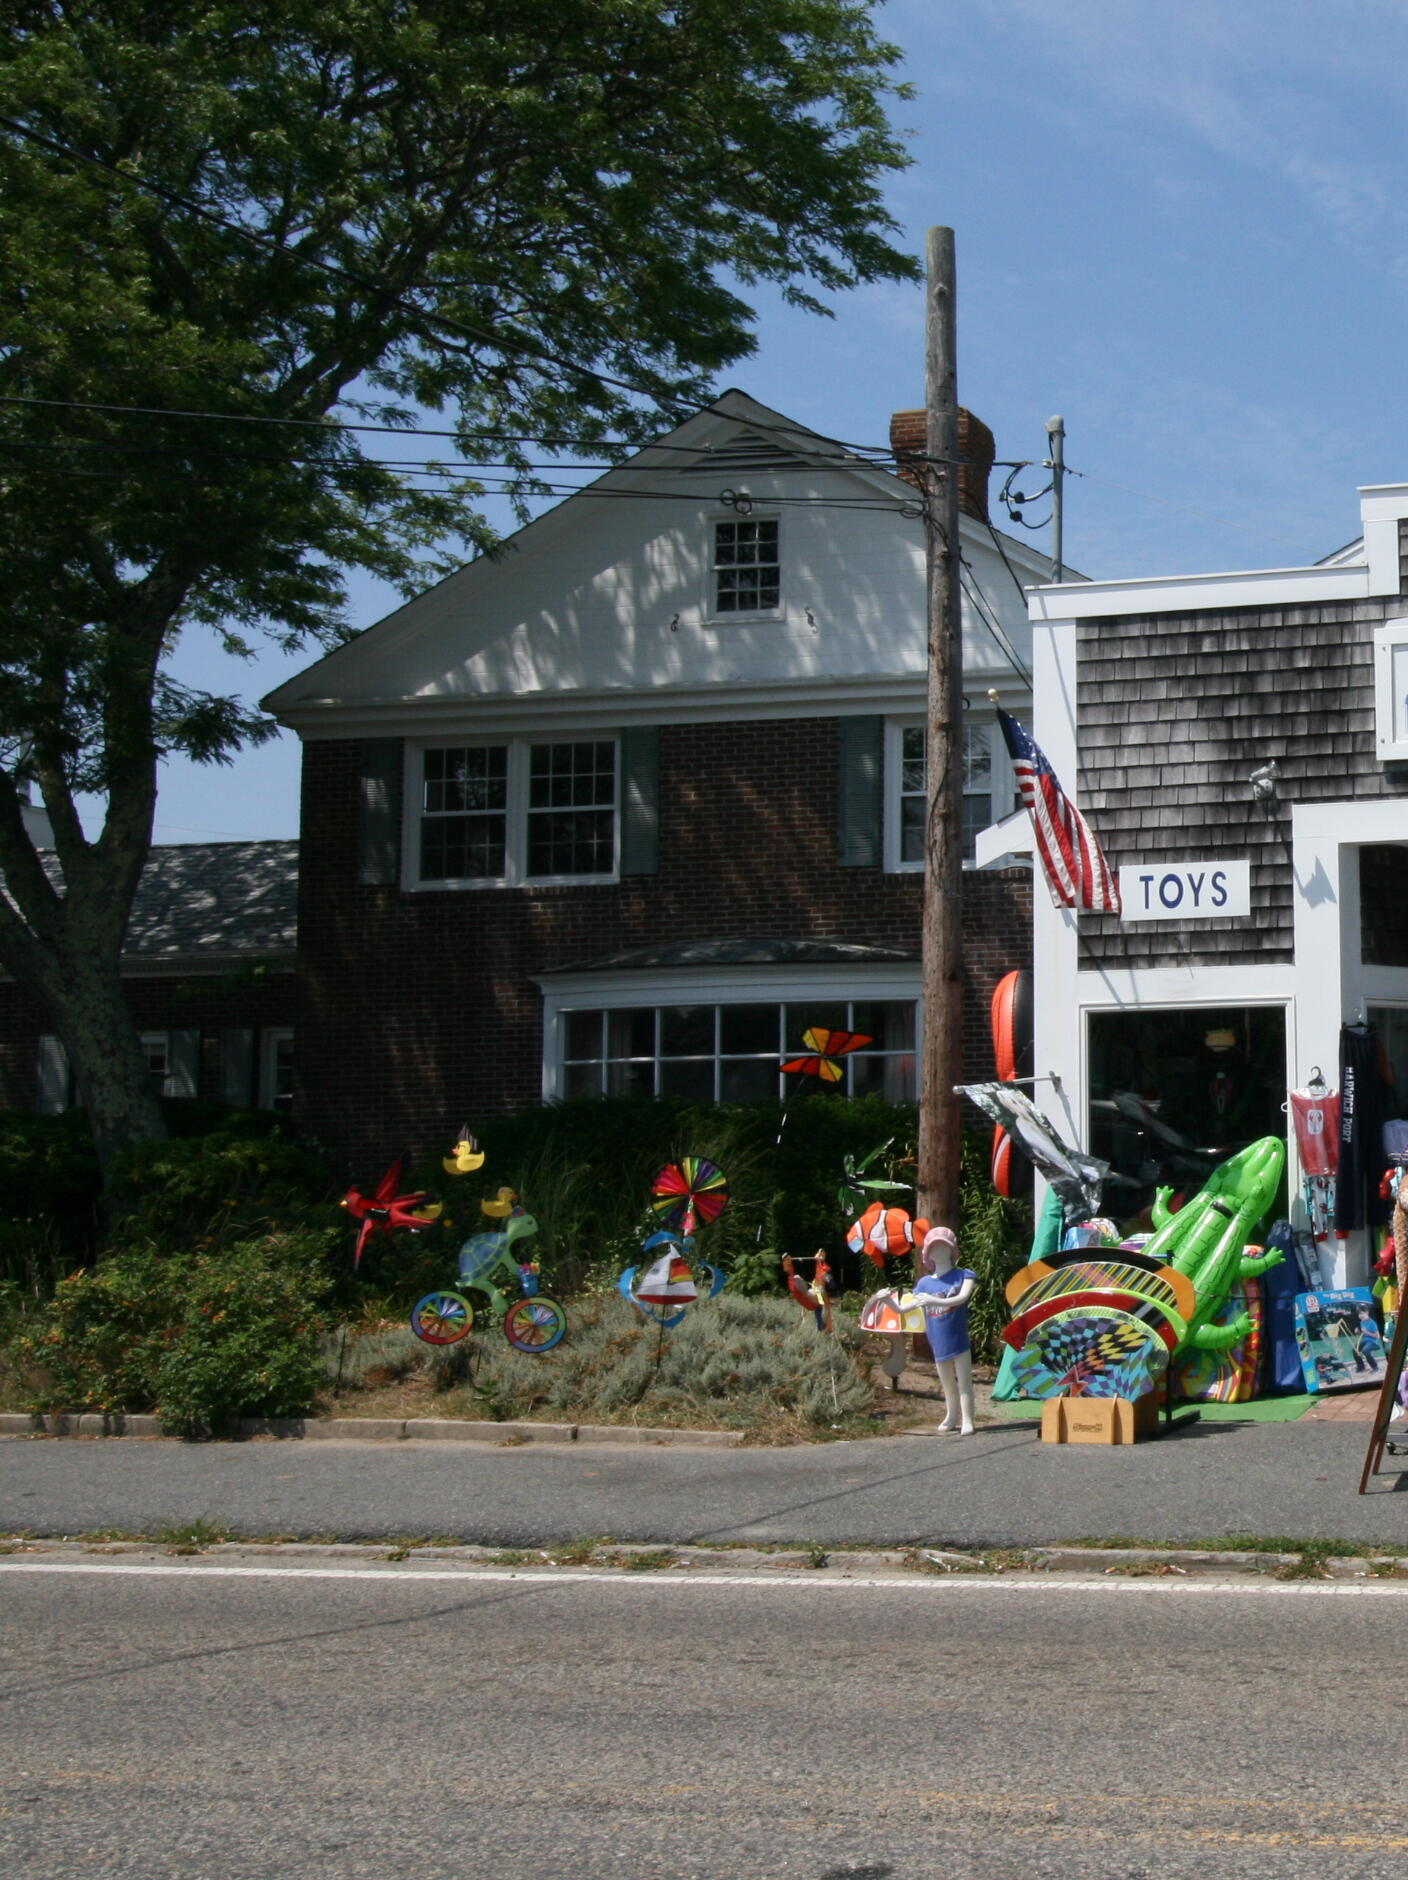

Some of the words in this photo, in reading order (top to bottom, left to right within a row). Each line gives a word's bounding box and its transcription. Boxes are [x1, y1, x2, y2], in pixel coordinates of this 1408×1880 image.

[1139, 871, 1228, 909] TOYS
[1343, 1066, 1355, 1115] HARWICH
[1342, 1118, 1353, 1143] PORT
